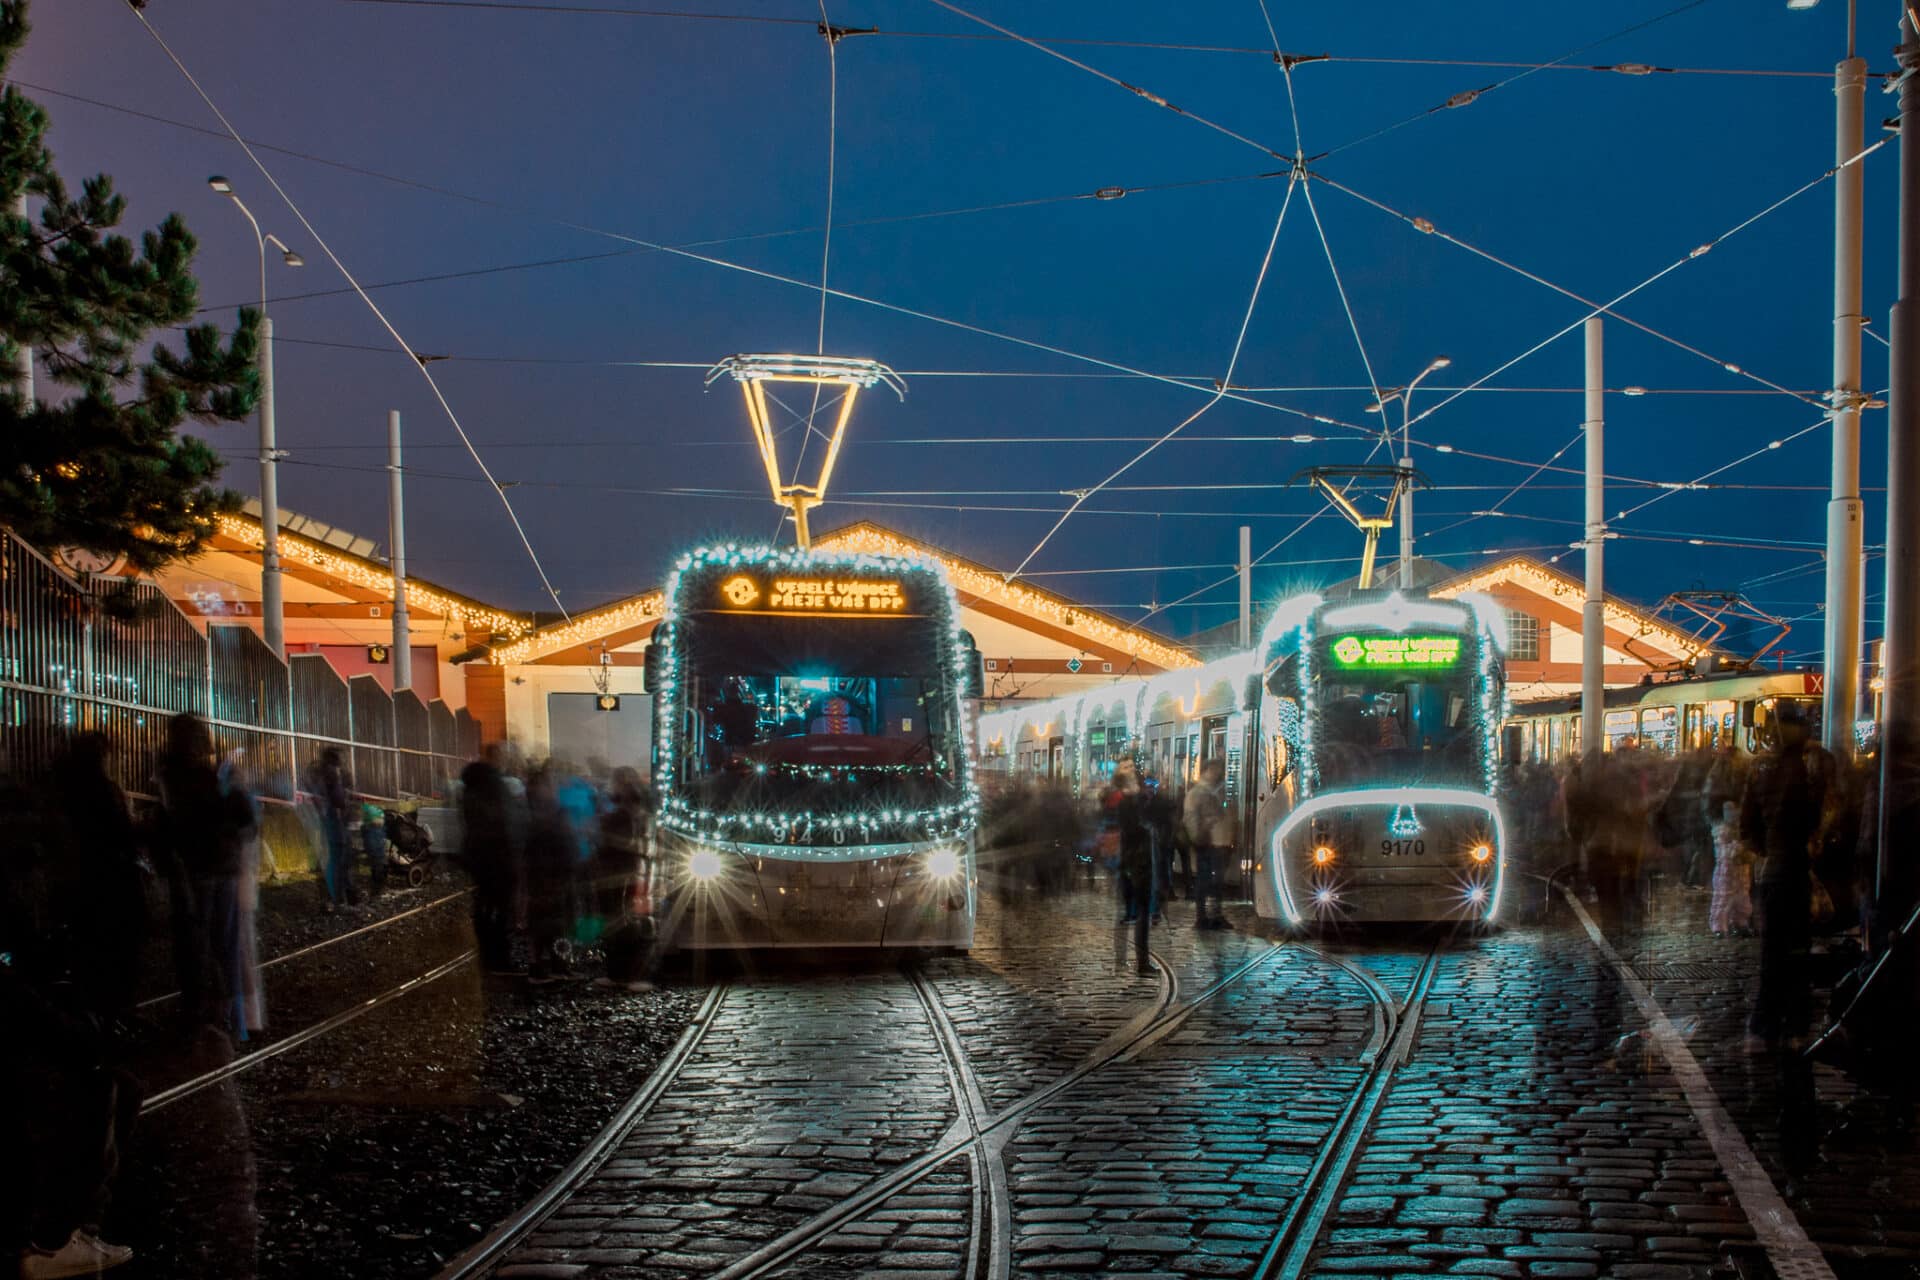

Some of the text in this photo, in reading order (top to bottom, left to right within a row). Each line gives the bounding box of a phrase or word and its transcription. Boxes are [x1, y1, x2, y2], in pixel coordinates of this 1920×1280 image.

[776, 580, 898, 596] VESELÉ VÁNOCE
[869, 596, 904, 608] DPP
[1811, 676, 1823, 692] X
[773, 826, 870, 844] 9401
[1382, 840, 1424, 856] 9170
